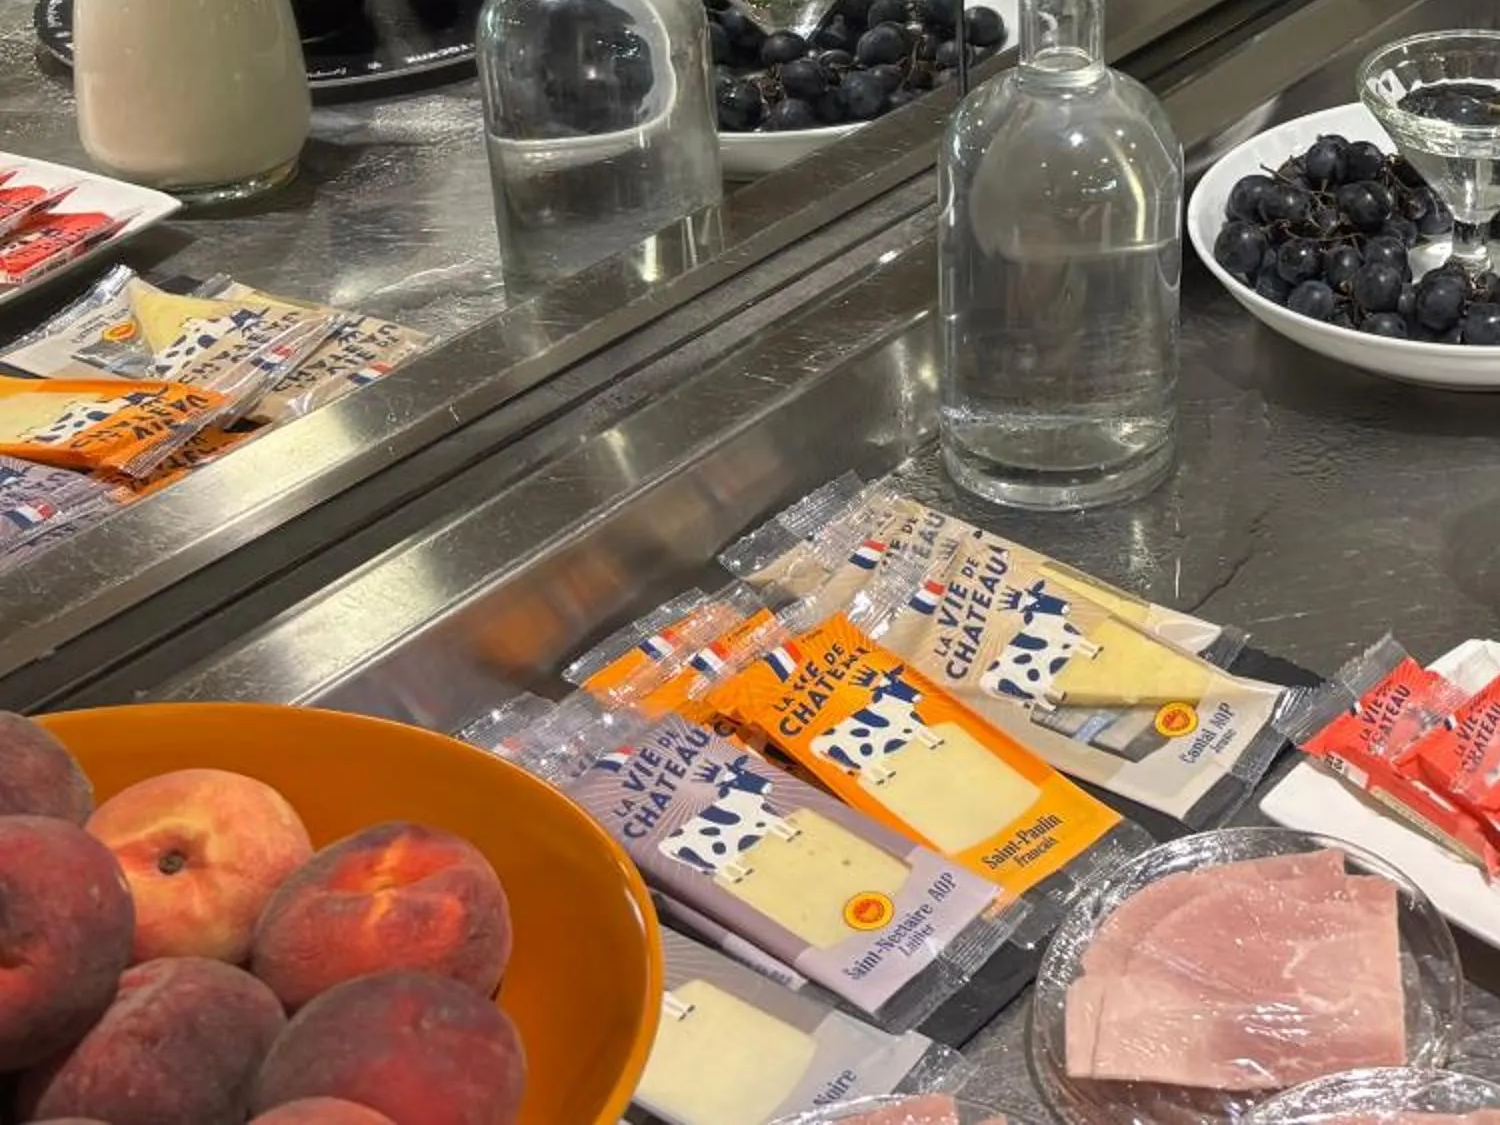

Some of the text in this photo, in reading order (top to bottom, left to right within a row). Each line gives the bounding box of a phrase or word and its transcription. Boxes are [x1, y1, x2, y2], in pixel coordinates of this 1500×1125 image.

[933, 556, 980, 657] LA VIE DE
[945, 543, 1010, 680] CHATEAU
[772, 693, 794, 713] LA
[822, 642, 846, 666] DE
[1361, 698, 1384, 725] VIE
[1456, 715, 1480, 742] VIE
[621, 746, 663, 793] VIE
[1178, 727, 1217, 765] Cantal
[614, 797, 636, 818] LA
[622, 727, 712, 840] CHATEAU
[981, 814, 1065, 871] Saint-Paulin
[842, 871, 959, 981] Saint-Nectaire AOP
